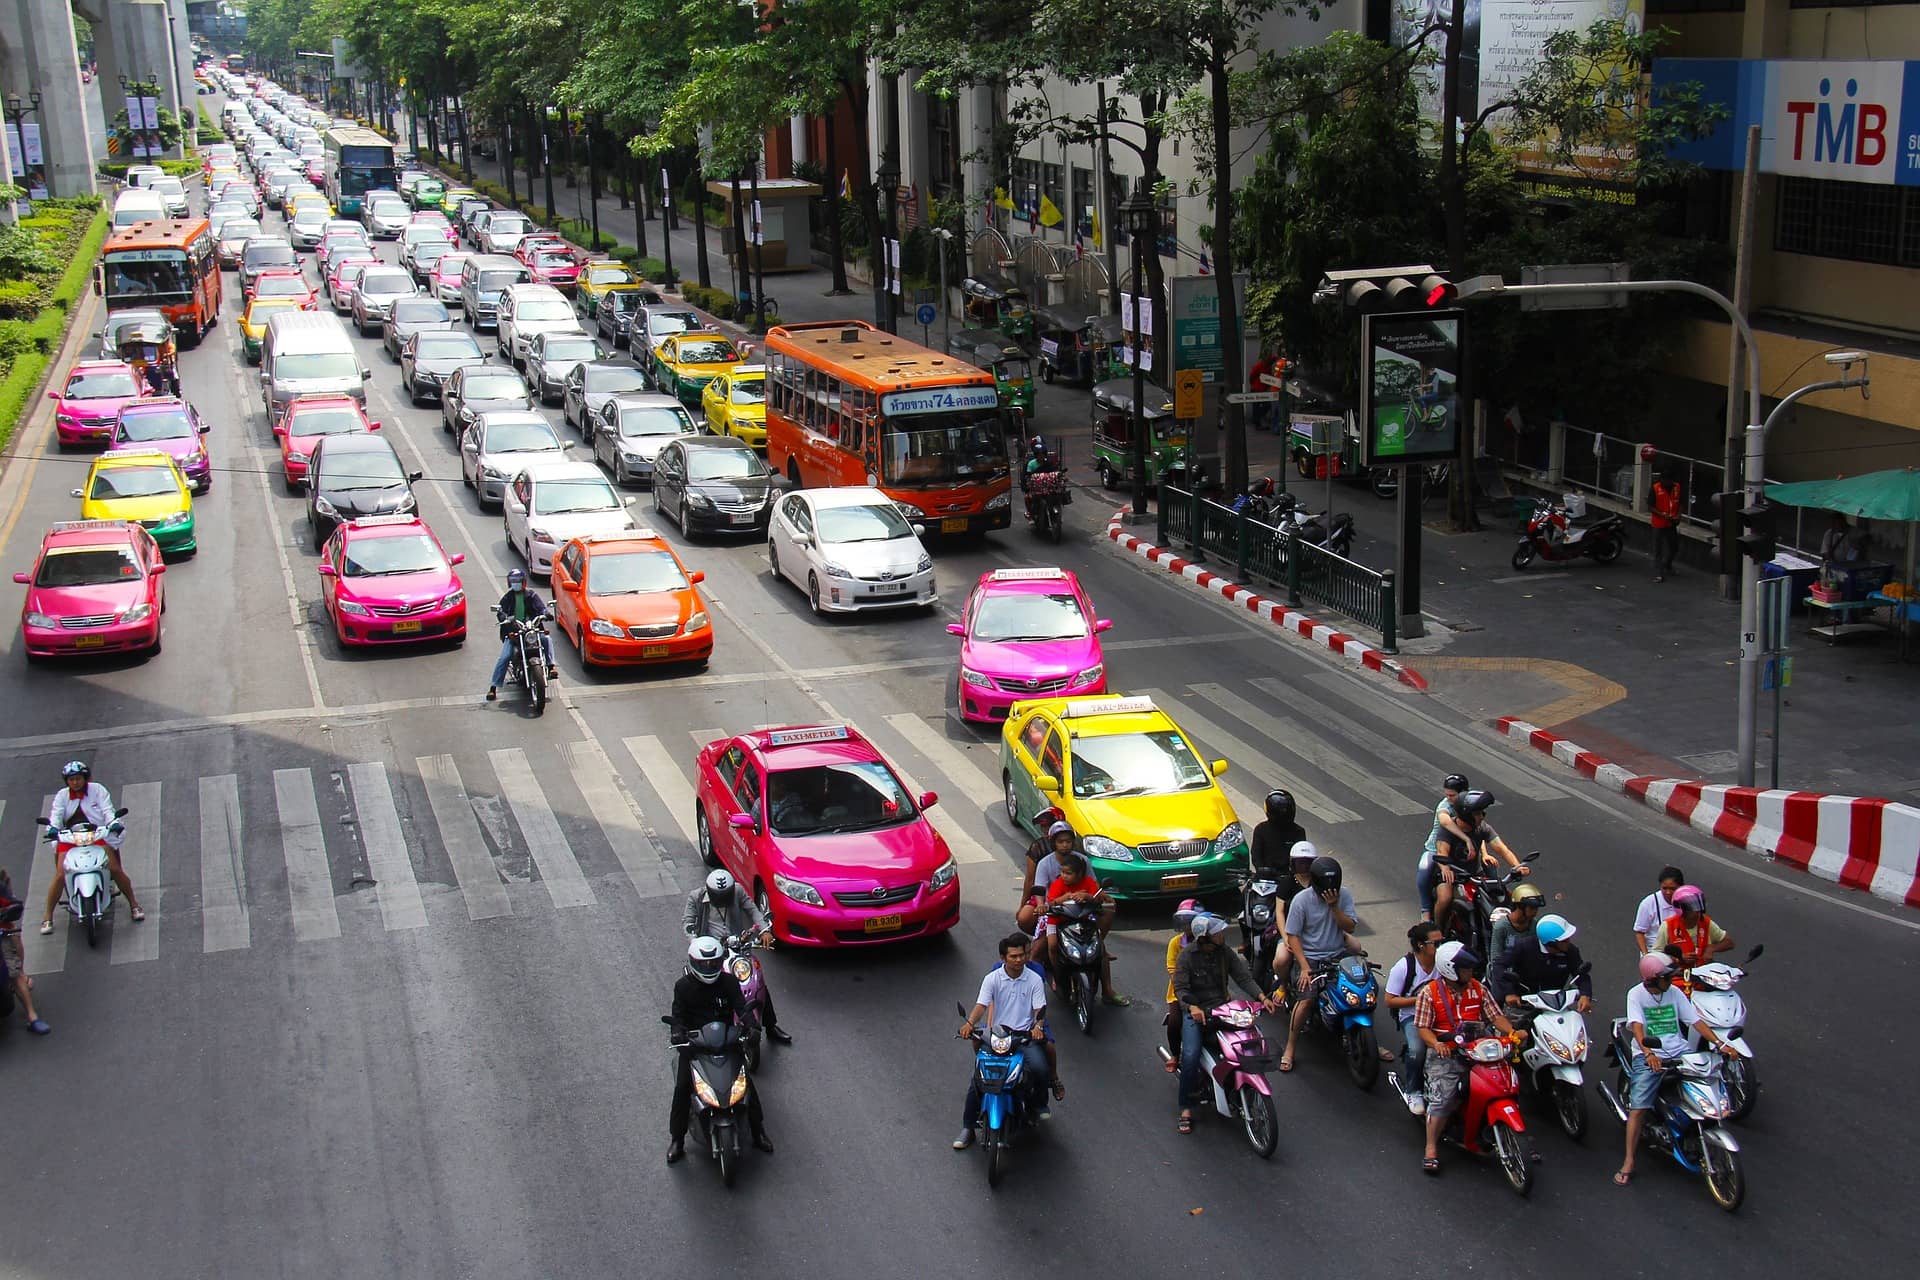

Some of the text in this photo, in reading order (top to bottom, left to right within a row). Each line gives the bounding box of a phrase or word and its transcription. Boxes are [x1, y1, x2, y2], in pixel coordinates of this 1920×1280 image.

[1787, 102, 1887, 166] TMB
[890, 398, 934, 412] ห้วยขวาง
[933, 393, 956, 408] 74
[1743, 633, 1755, 643] 10
[782, 730, 837, 742] TAXI-METER
